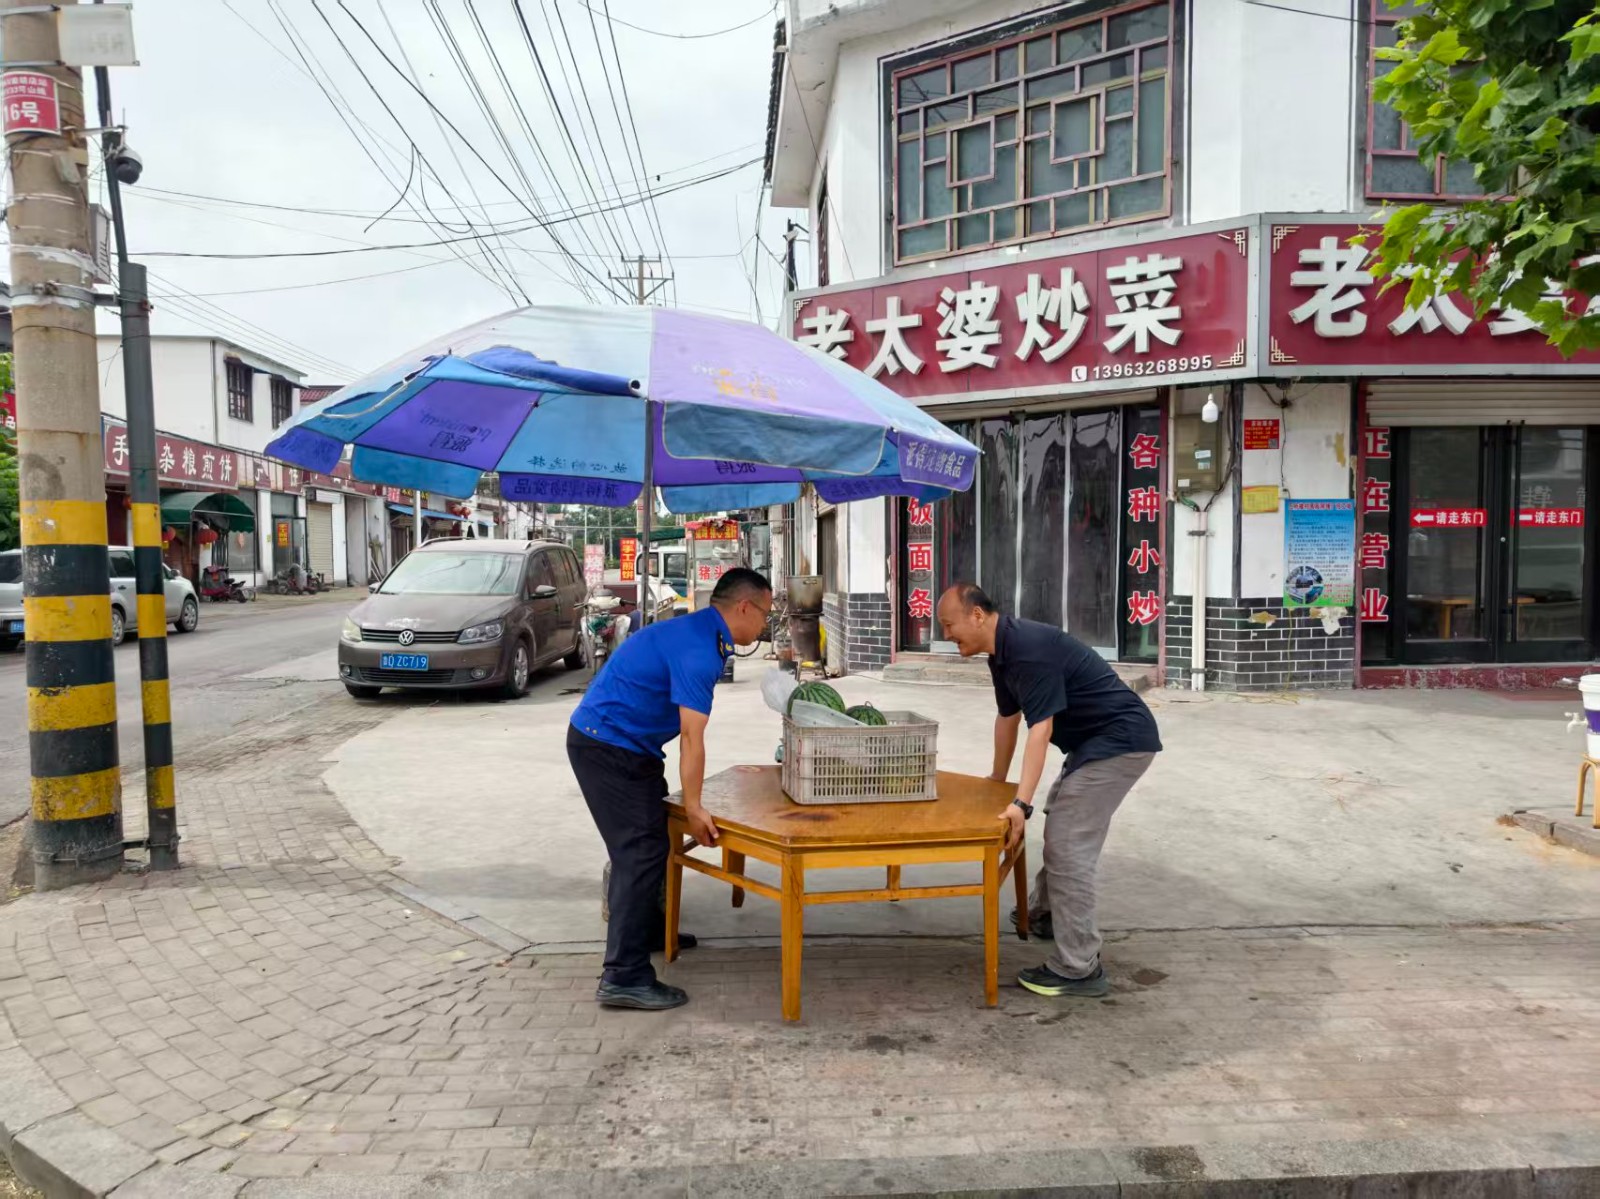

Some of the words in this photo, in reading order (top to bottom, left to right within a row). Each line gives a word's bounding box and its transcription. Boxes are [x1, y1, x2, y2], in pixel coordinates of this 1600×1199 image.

[799, 252, 1184, 379] 老太婆炒菜
[1093, 354, 1212, 379] 13963268995
[112, 434, 232, 482] 手杂粮煎饼
[1128, 433, 1161, 625] 各种小炒
[1360, 426, 1391, 622] 正在营业
[1436, 511, 1484, 525] 请走东门
[1535, 511, 1581, 524] 请走东门
